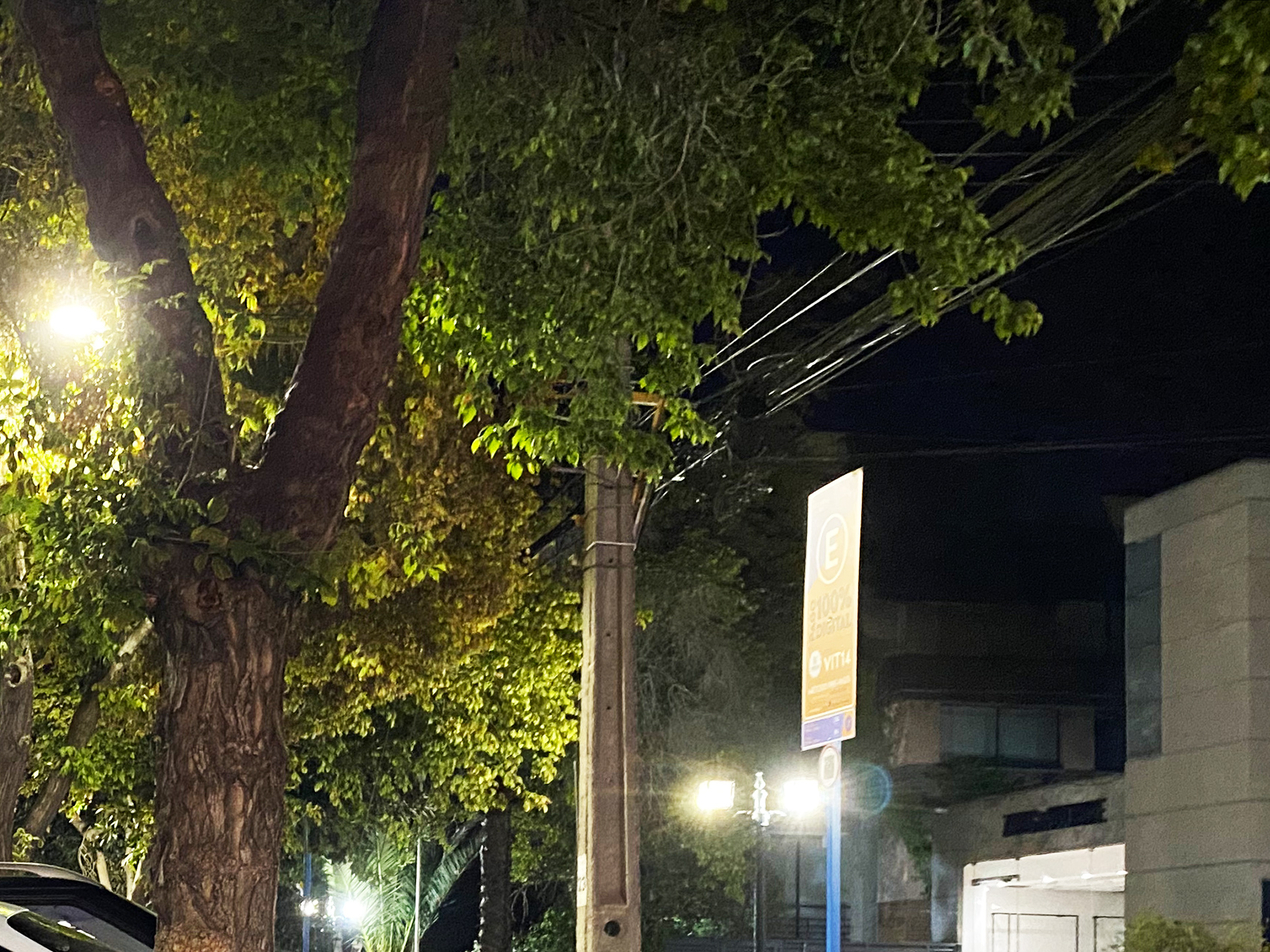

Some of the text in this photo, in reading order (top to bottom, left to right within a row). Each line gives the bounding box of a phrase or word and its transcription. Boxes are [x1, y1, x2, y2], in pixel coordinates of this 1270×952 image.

[825, 526, 839, 570] E
[816, 583, 851, 620] 100%
[823, 648, 852, 672] VIT14
